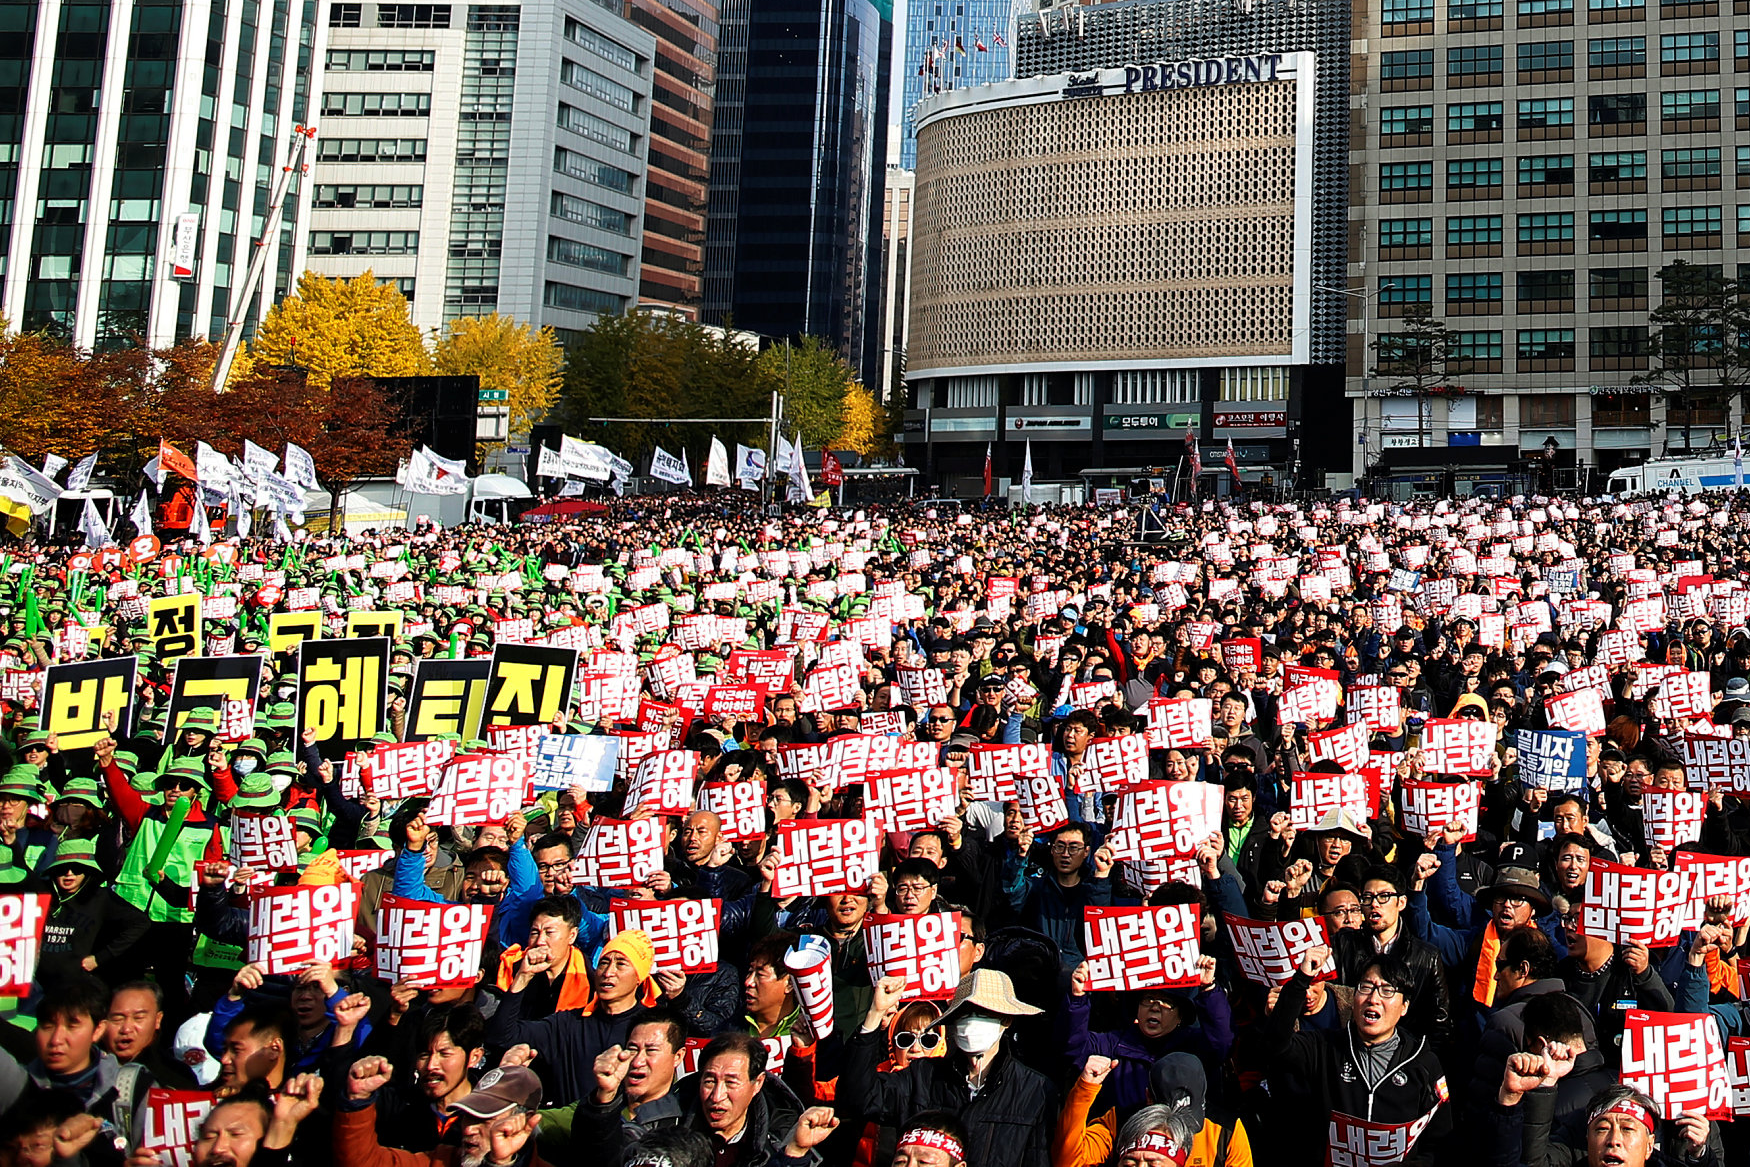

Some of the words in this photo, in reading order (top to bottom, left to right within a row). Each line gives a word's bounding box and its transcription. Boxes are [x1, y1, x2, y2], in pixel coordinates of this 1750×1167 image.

[1124, 54, 1282, 93] PRESIDENT
[1658, 478, 1694, 487] CHANNEL
[153, 605, 196, 659] 정
[749, 659, 792, 677] 박근혜
[1224, 645, 1254, 656] 박근혜는
[714, 688, 757, 700] 박근혜는
[900, 668, 944, 690] 내려와
[302, 653, 379, 749] 혜
[711, 700, 755, 712] 하야하라
[1147, 699, 1212, 729] 내려와
[1348, 687, 1399, 711] 내려와
[860, 713, 902, 733] 박근혜
[1422, 721, 1497, 751] 내려와
[1085, 735, 1146, 769] 내려와
[1517, 729, 1574, 759] 끝내자
[437, 756, 525, 803] 내려와
[628, 750, 698, 793] 내려와
[1518, 754, 1571, 778] 노동개악
[426, 787, 523, 823] 박근혜
[864, 767, 953, 807] 내려와
[1291, 774, 1367, 808] 내려와
[1401, 784, 1480, 816] 내려와
[581, 817, 663, 857] 내려와
[782, 820, 880, 867] 내려와
[1513, 847, 1523, 860] P
[777, 852, 879, 896] 박근혜
[1585, 869, 1697, 909] 내려와
[249, 886, 353, 936] 내려와
[377, 904, 485, 947] 내려와
[1583, 902, 1689, 946] 박근혜
[44, 925, 75, 936] VARSITY
[47, 934, 67, 943] 1973
[863, 911, 960, 964] 내려와
[1085, 904, 1197, 958] 내려와
[1227, 916, 1325, 959] 내려와
[377, 939, 483, 985] 박근혜
[1088, 937, 1201, 991] 박근혜
